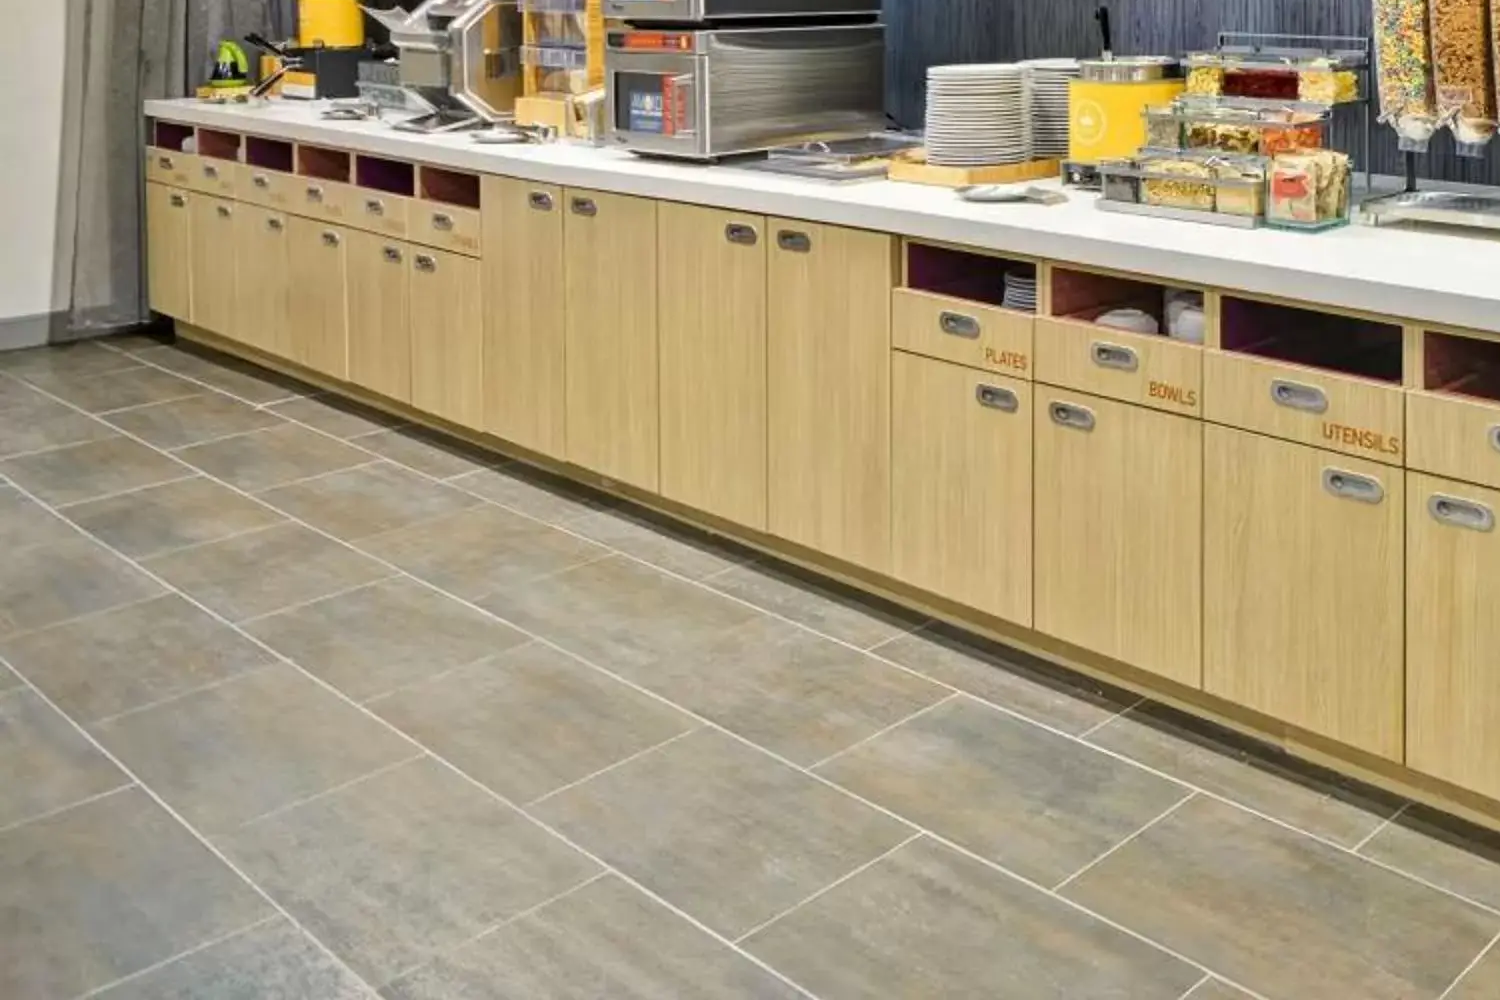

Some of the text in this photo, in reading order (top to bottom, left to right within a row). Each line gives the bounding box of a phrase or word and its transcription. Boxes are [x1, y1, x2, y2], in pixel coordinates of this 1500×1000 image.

[985, 347, 1028, 371] PLATES
[1149, 381, 1196, 407] BOWLS
[1322, 421, 1400, 455] UTENSILS
